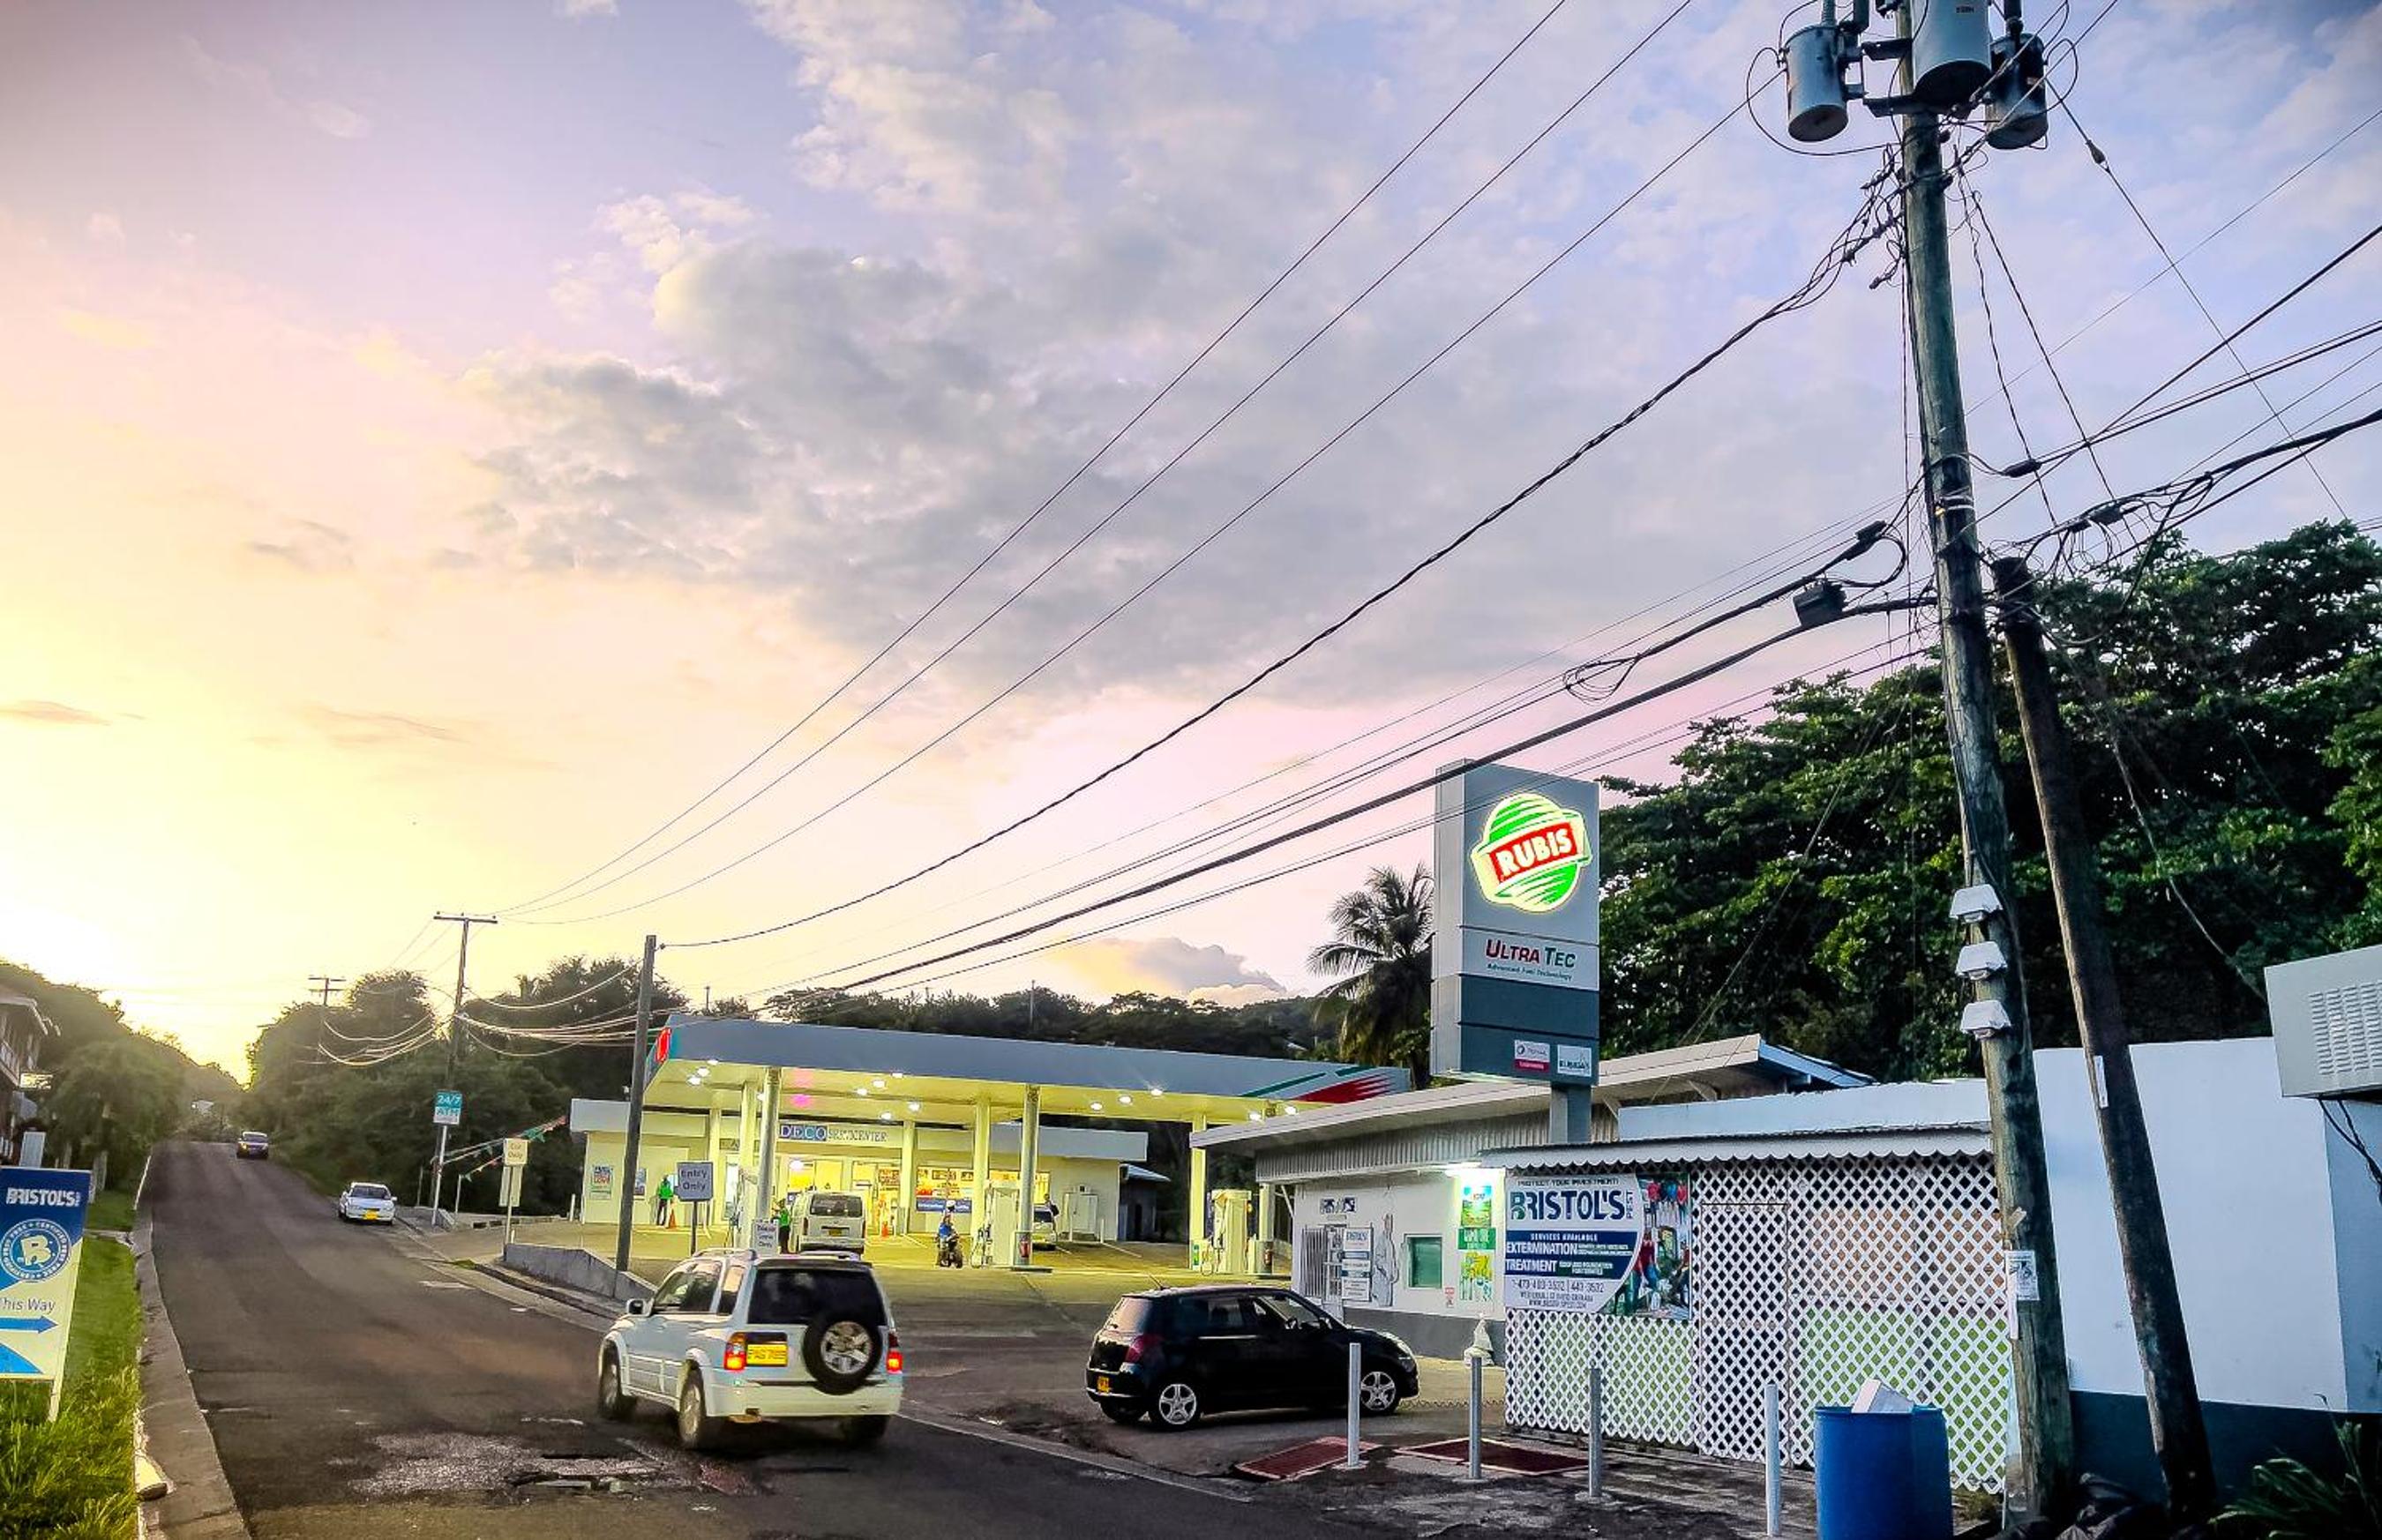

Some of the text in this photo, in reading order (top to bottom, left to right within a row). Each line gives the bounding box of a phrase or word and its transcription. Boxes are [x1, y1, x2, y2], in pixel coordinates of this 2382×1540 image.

[1495, 828, 1572, 877] RUBIS
[1486, 939, 1576, 968] ULTRA TEC
[438, 1095, 461, 1104] 24/7
[781, 1125, 827, 1140] DECO
[681, 1169, 707, 1178] Entry
[682, 1181, 706, 1191] Only
[6, 1187, 74, 1207] BRISTOL'S
[1509, 1190, 1625, 1220] BRISTOL'S
[1506, 1240, 1578, 1255] EXTERMINATION
[1505, 1258, 1558, 1273] TREATMENT
[0, 1297, 56, 1314] his Way
